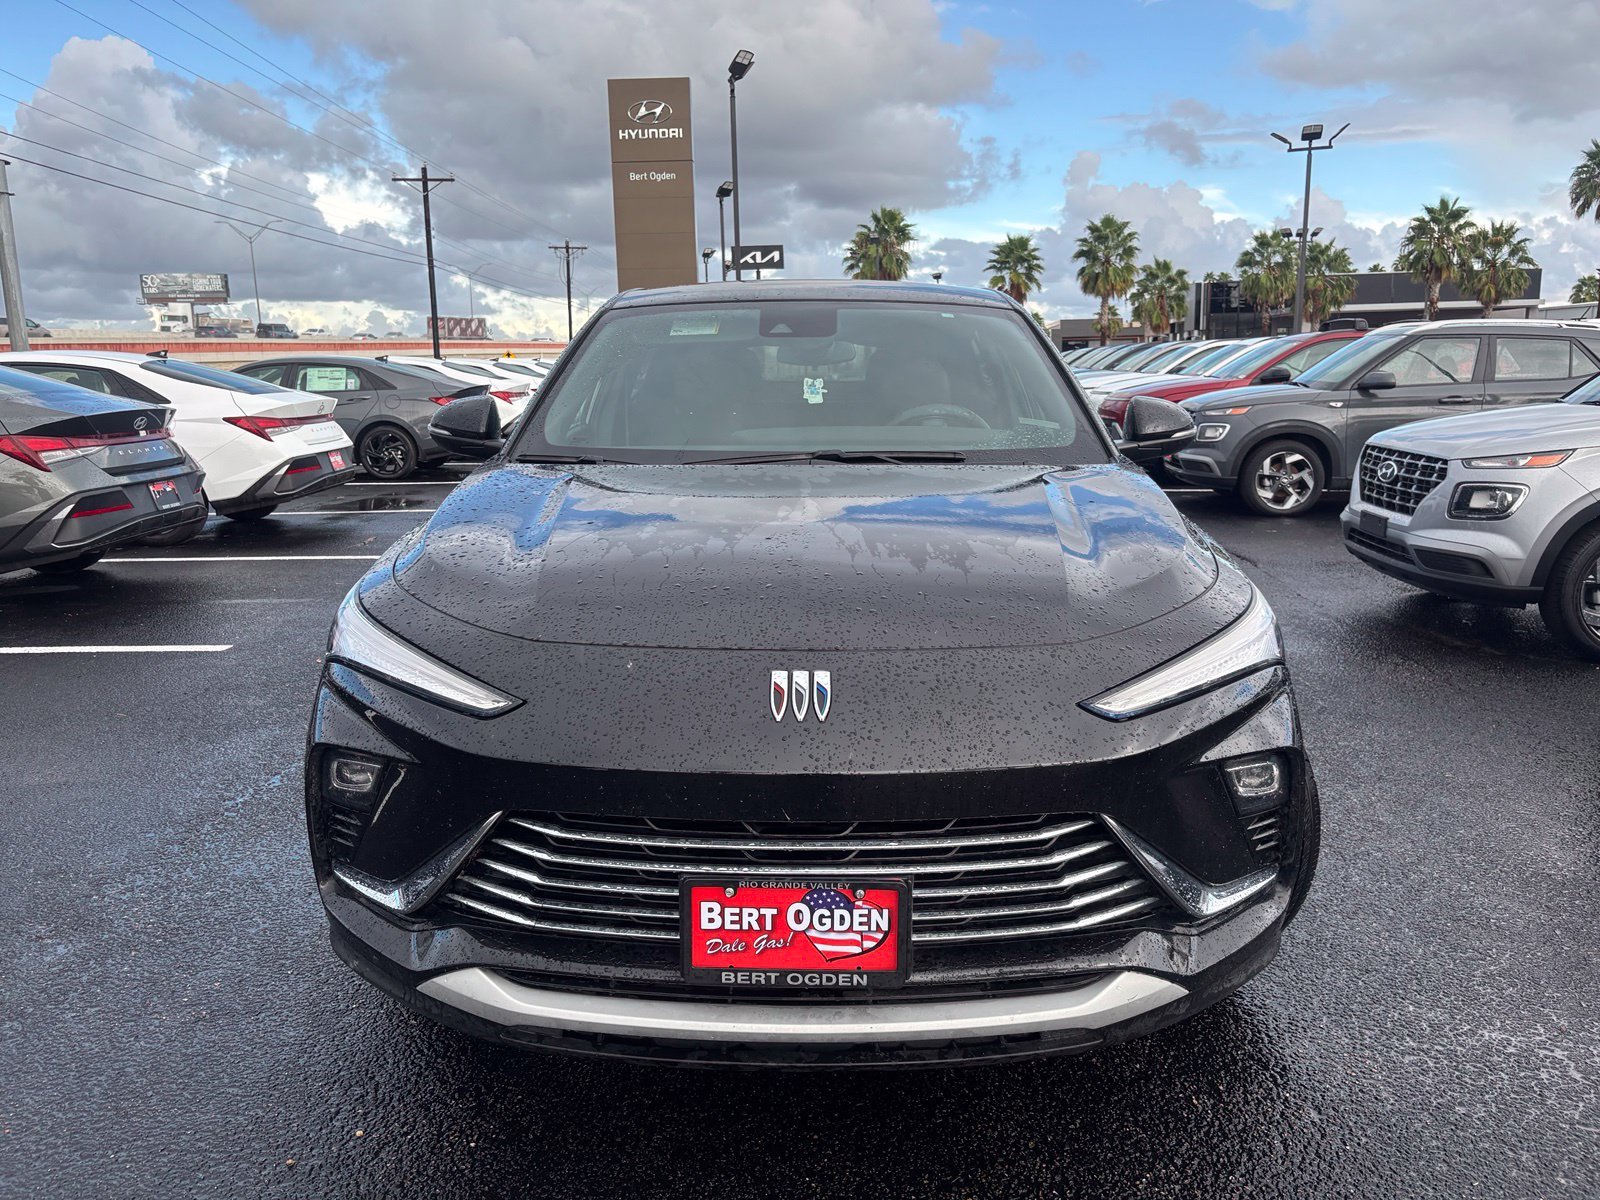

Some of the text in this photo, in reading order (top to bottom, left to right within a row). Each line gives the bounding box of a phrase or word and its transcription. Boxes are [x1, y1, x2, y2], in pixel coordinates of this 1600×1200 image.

[618, 127, 683, 140] HYUNDAI
[629, 171, 676, 182] Bert Ogden
[739, 250, 780, 264] KIA
[738, 881, 850, 890] RIO GRANDE VALLEY
[700, 901, 889, 932] BERT OGDEN
[706, 931, 794, 955] Dale Gas!
[721, 971, 868, 986] BERT OGDEN
